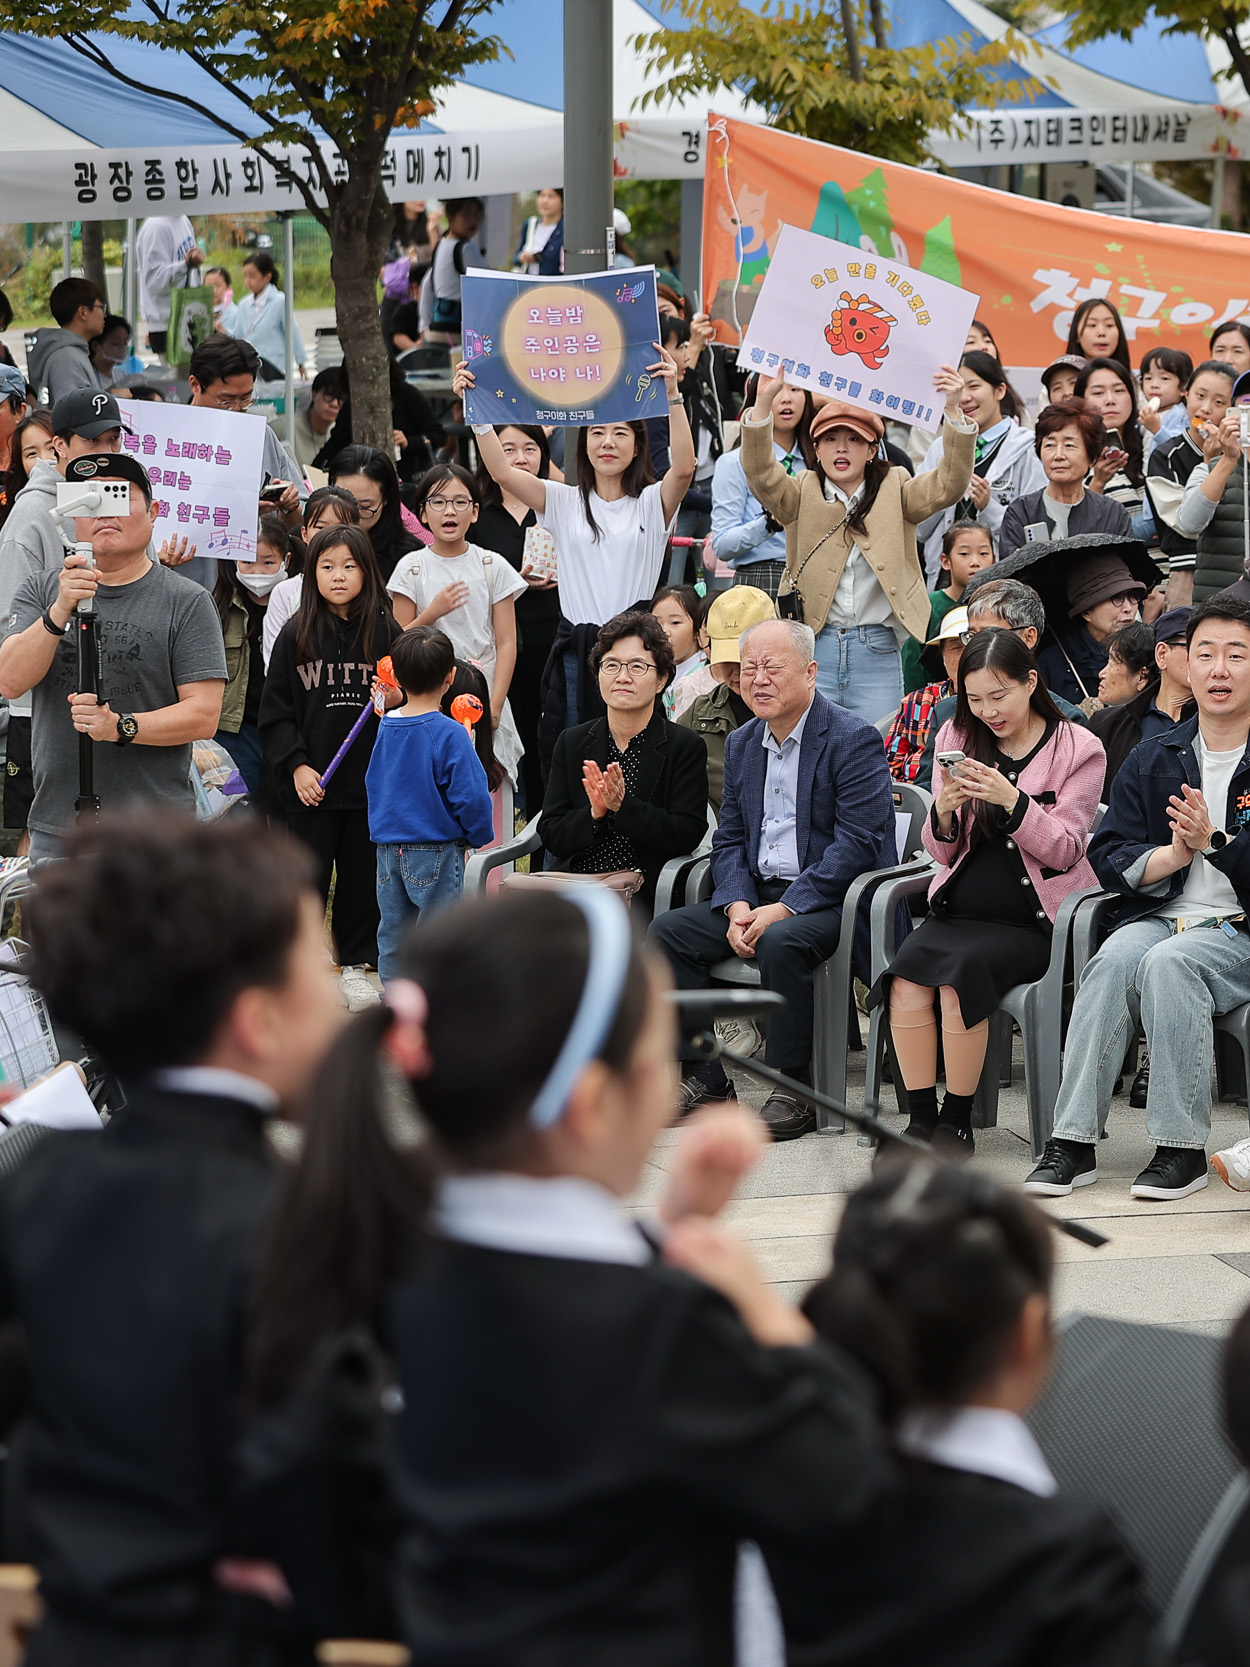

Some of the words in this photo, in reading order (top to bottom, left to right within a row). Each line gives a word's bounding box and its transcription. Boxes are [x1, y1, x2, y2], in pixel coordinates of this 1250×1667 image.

[811, 267, 839, 289] 오늘
[847, 262, 877, 280] 만을
[886, 271, 931, 326] 기다렸다
[528, 305, 584, 326] 오늘밤
[525, 334, 601, 355] 주인공은
[530, 367, 567, 382] 나야
[575, 365, 602, 382] 나!
[750, 346, 811, 379] 청구이화
[818, 371, 862, 398] 친구들
[869, 388, 933, 422] 화이팅!!
[92, 394, 109, 416] P
[536, 410, 567, 421] 청구이화
[569, 410, 595, 421] 친구들
[121, 433, 157, 455] 복을
[165, 438, 232, 465] 노래하는
[149, 467, 192, 491] 우리는
[177, 502, 230, 527] 친구들
[296, 659, 379, 691] WITT
